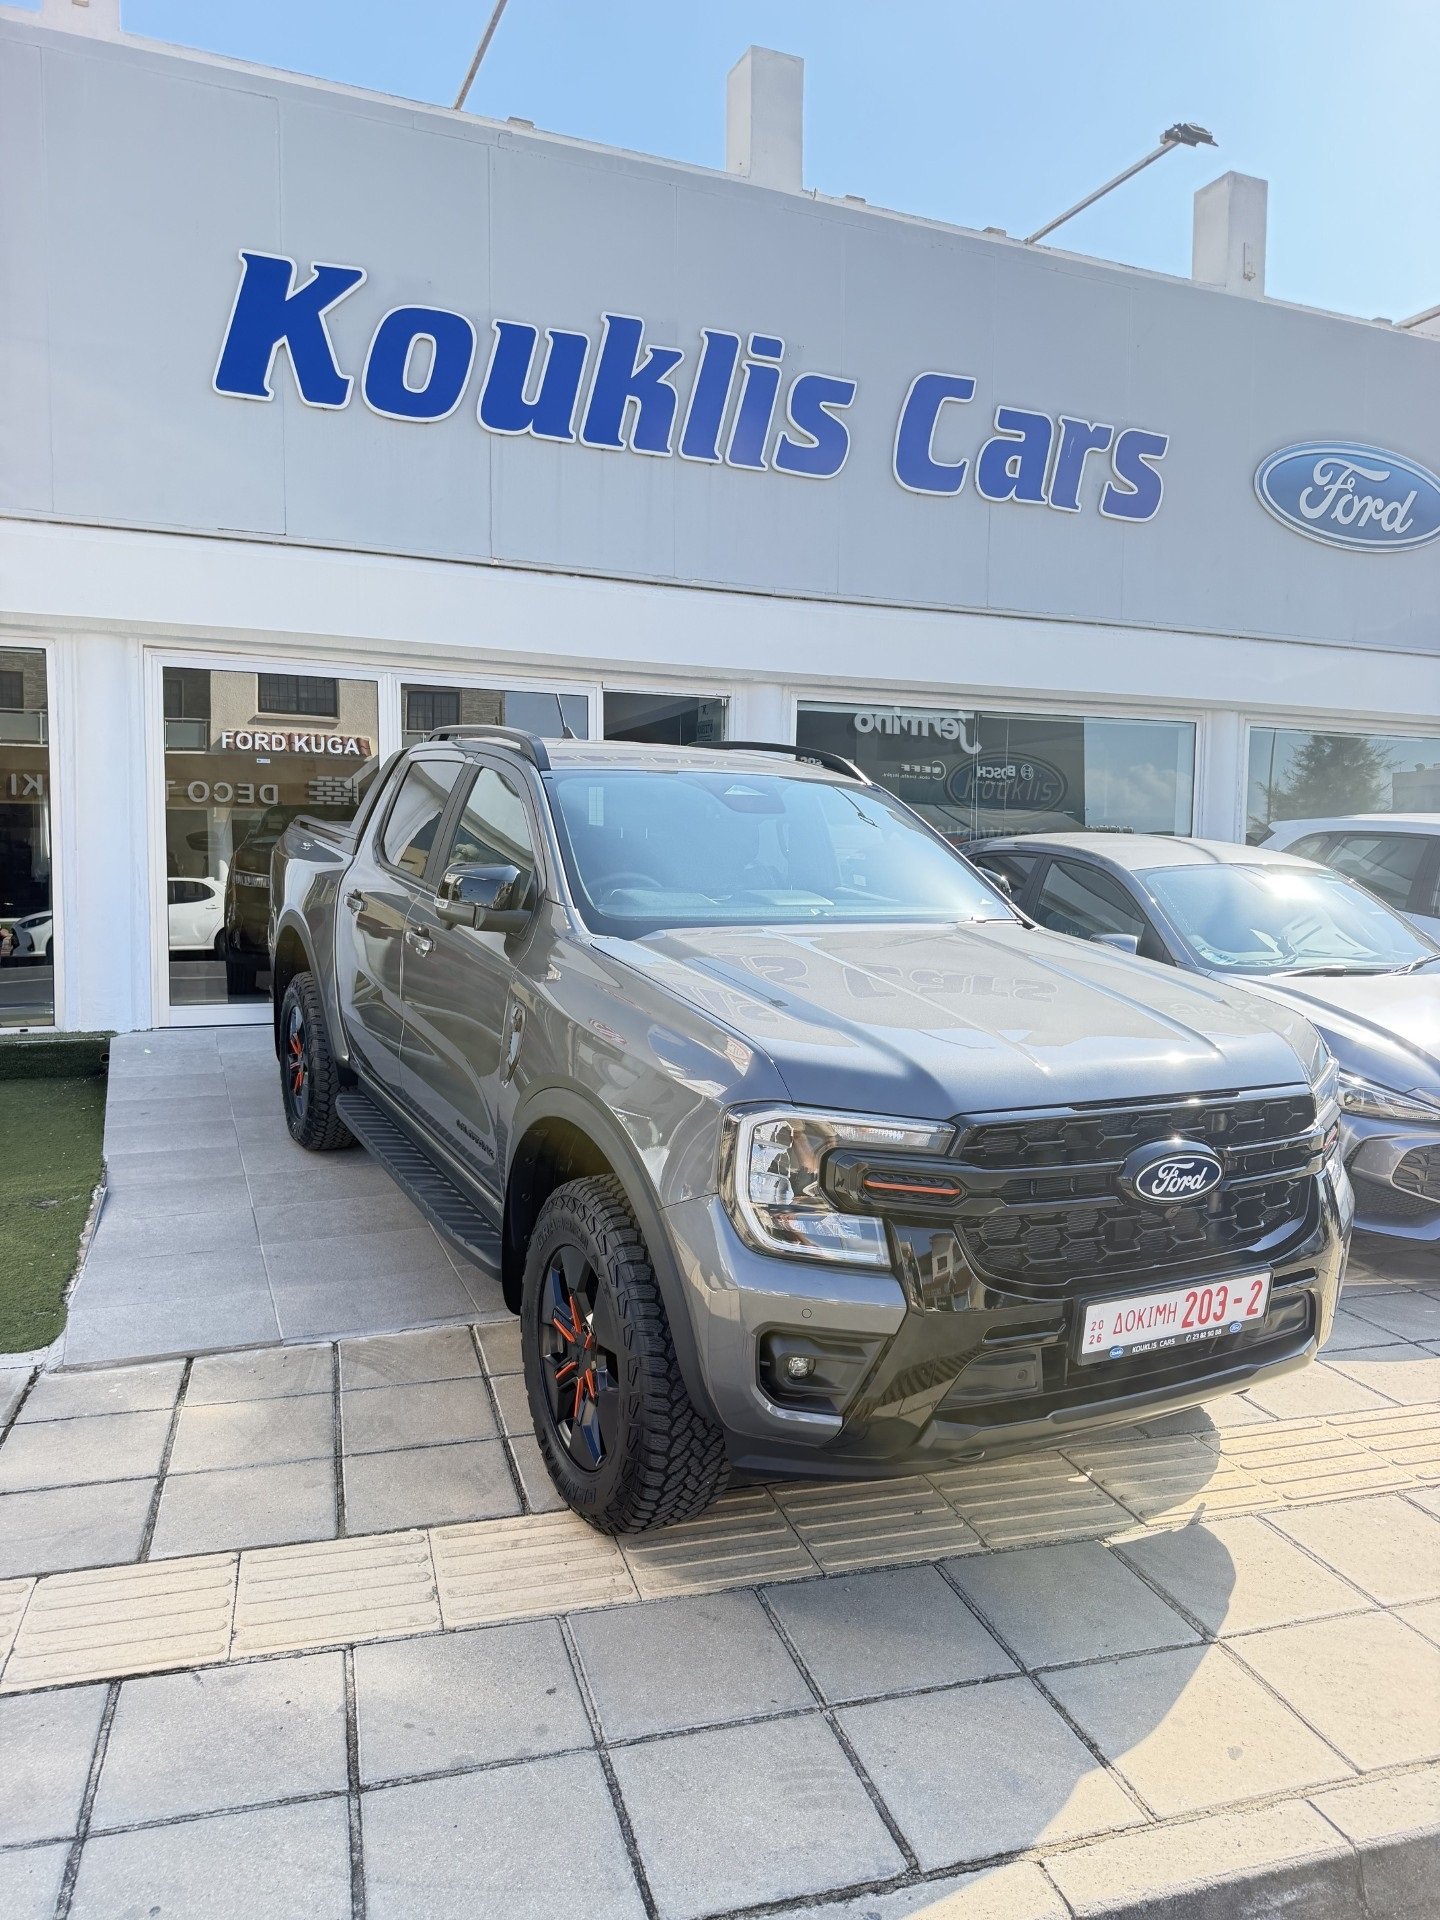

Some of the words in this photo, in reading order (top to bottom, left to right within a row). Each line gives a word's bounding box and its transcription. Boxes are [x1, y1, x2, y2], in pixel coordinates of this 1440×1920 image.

[212, 248, 857, 479] Kouklis
[893, 372, 1169, 521] Cars
[1300, 457, 1417, 533] Ford
[221, 731, 286, 752] FORD
[294, 735, 360, 755] KUGA
[1152, 1162, 1208, 1194] Ford
[1091, 1320, 1104, 1331] 20
[1113, 1301, 1178, 1334] ΔΟΚΙΜΗ
[1089, 1334, 1102, 1345] 26
[1131, 1341, 1157, 1354] KOUKLIS
[1160, 1338, 1176, 1347] CARS
